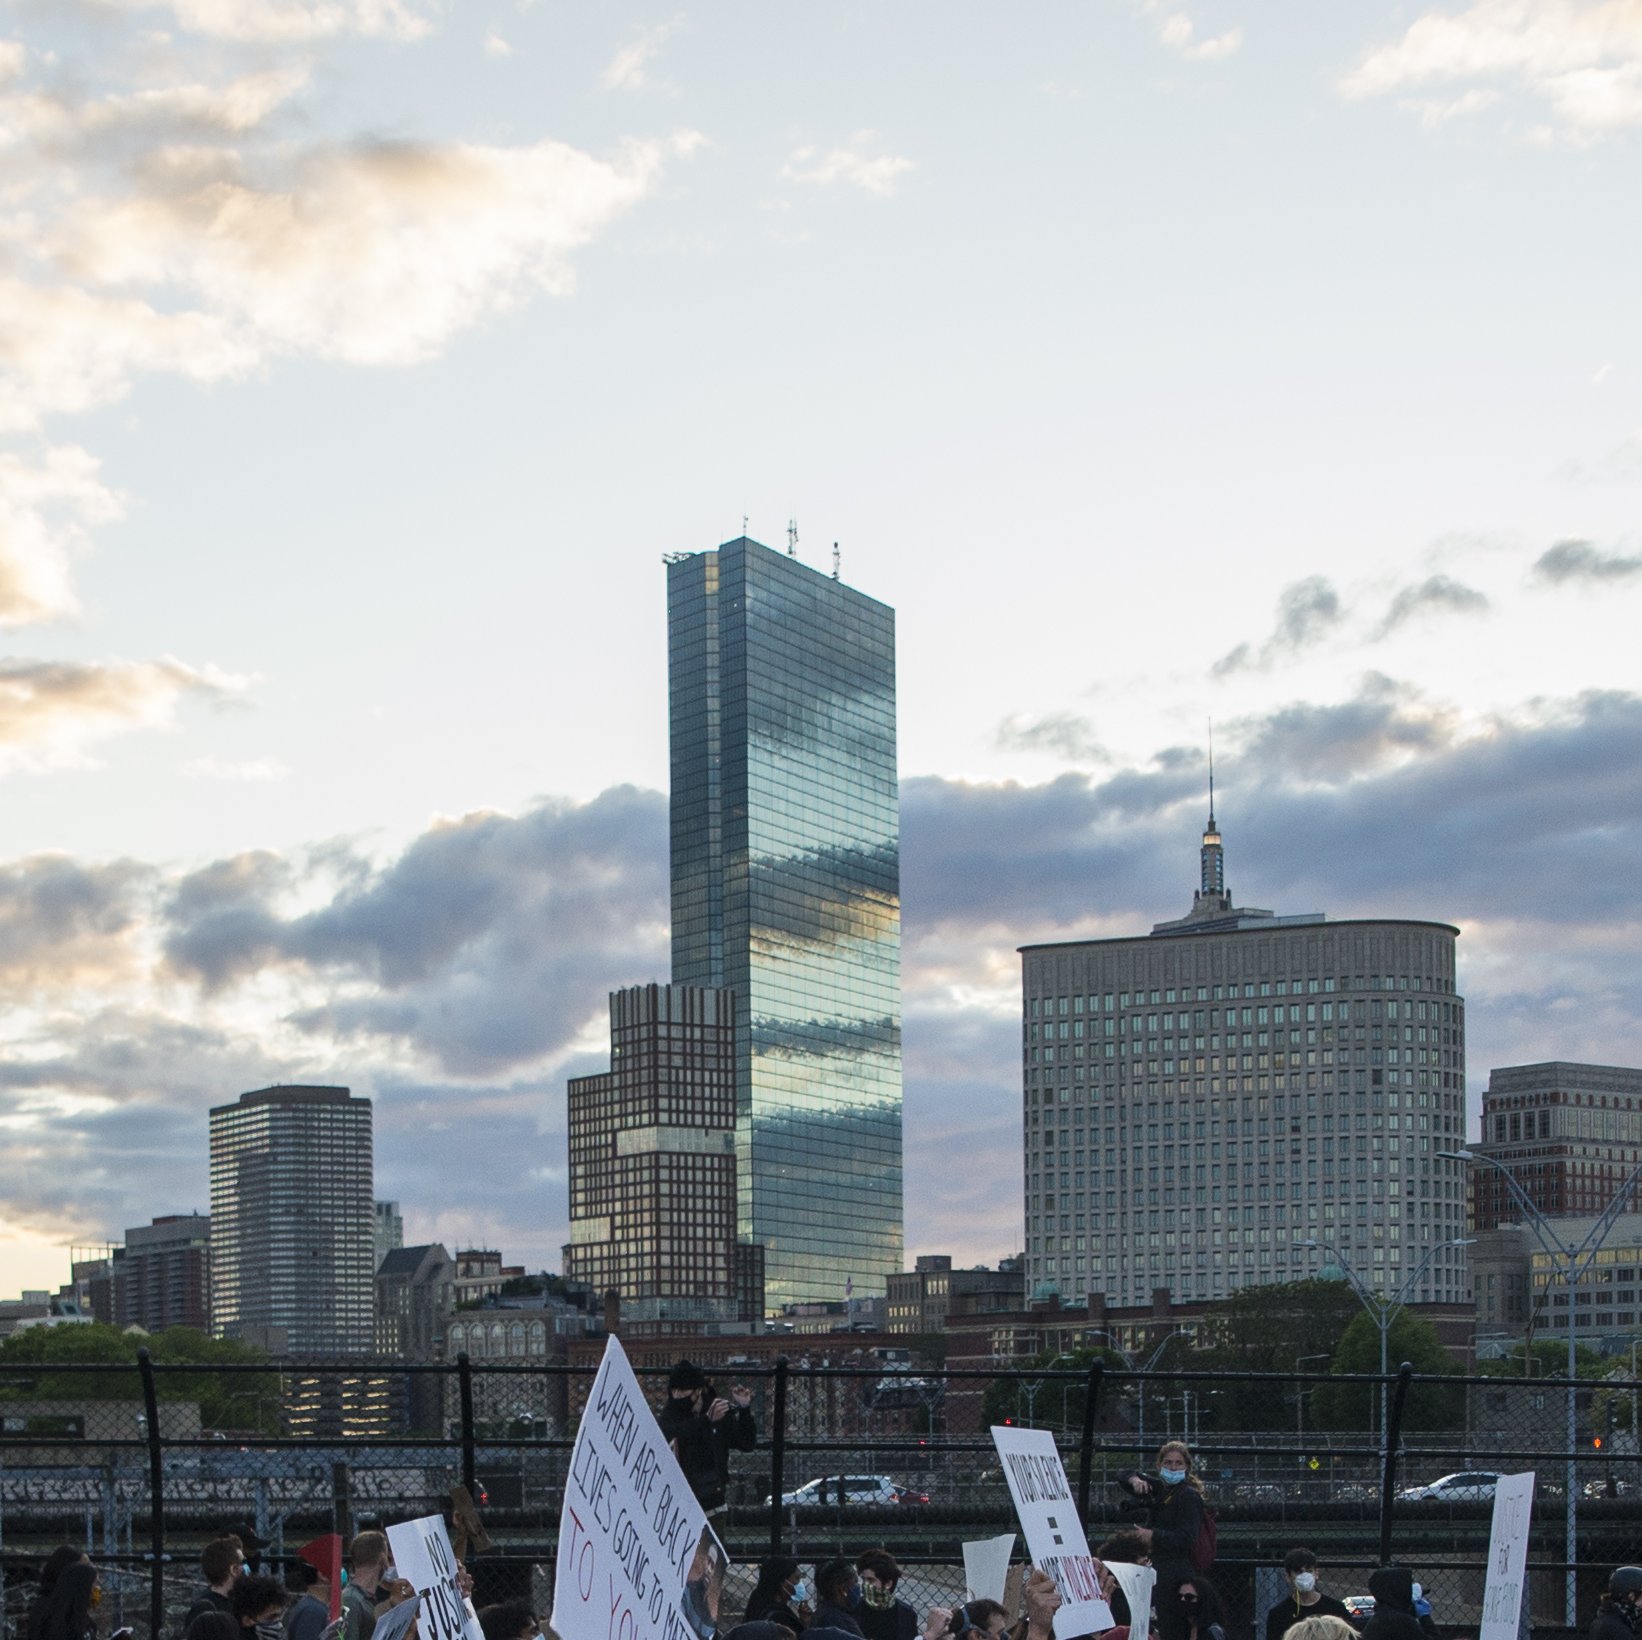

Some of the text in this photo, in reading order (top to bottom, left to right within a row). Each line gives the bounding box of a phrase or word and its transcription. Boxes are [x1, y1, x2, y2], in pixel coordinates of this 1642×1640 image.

[573, 1426, 617, 1533] LIVES
[613, 1508, 649, 1599] GOING
[648, 1573, 663, 1624] TO
[597, 1361, 696, 1588] WHEN ARE BLACK
[424, 1532, 450, 1576] NO
[569, 1506, 594, 1601] TO
